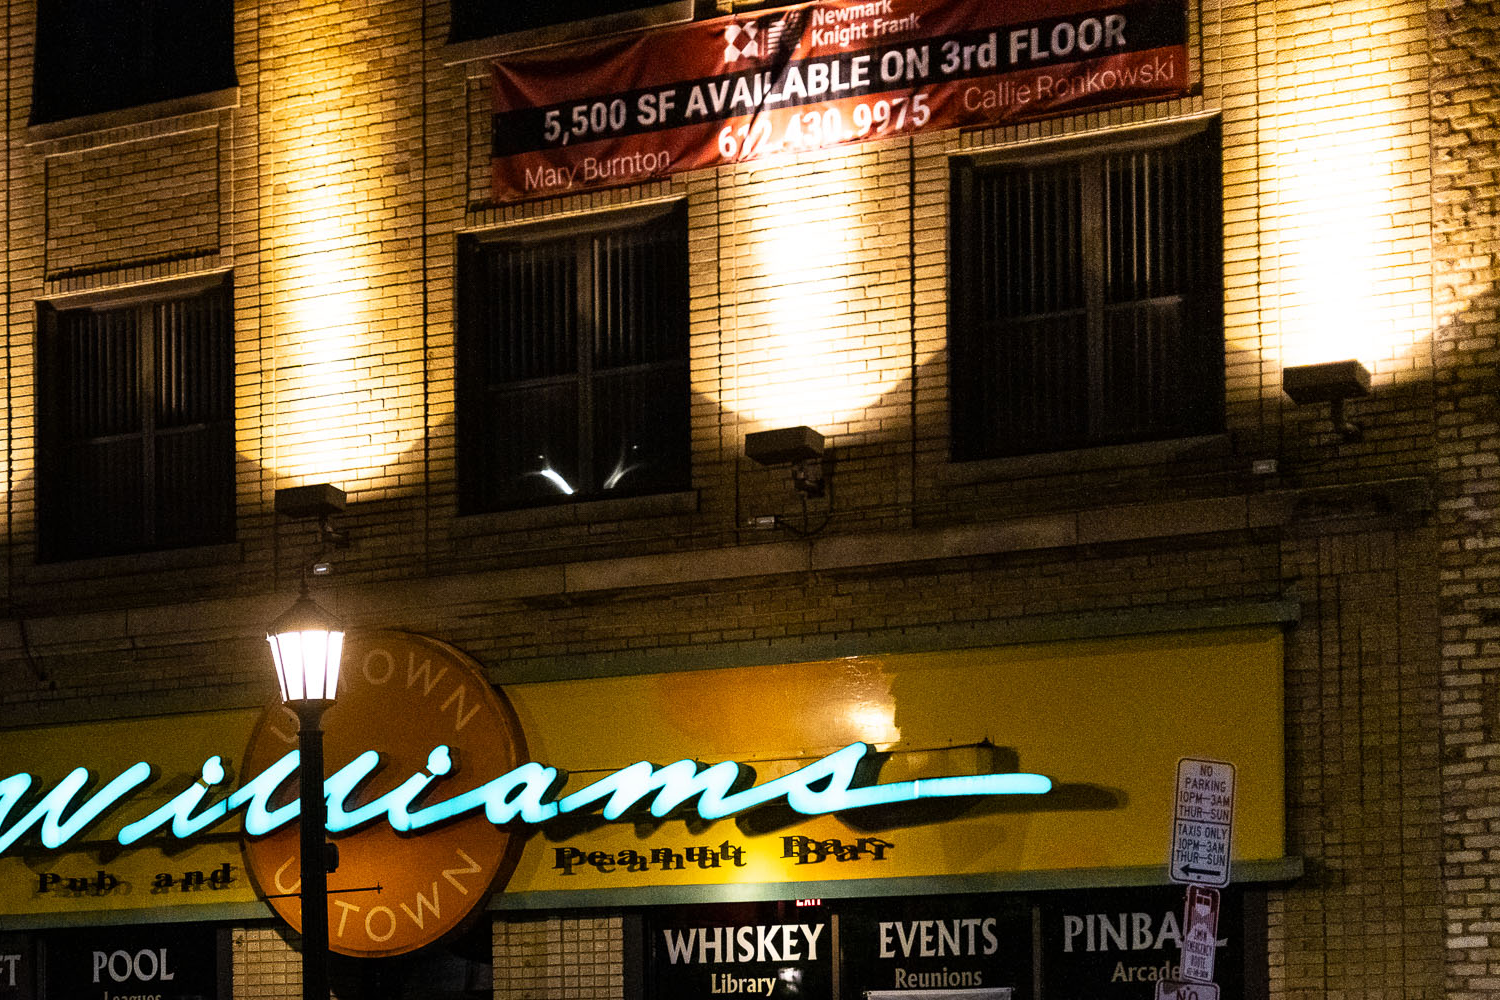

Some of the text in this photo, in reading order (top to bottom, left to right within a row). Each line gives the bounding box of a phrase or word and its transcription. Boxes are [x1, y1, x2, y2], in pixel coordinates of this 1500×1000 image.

[811, 13, 921, 47] Knight Frank
[812, 0, 893, 27] Newmark
[544, 14, 1127, 145] 5,500 SF AVAILABLE ON 3rd FLOOR
[965, 54, 1175, 112] Callie Ronkowski
[719, 93, 932, 158] 612.430.9975
[524, 150, 671, 191] Mary Burnton
[1185, 777, 1227, 793] PARKING
[1200, 765, 1213, 777] NO
[1178, 823, 1228, 840] TAXIS ONLY
[36, 834, 890, 894] Pub and Peanut Bar
[274, 848, 483, 942] UTOWN
[663, 923, 825, 965] WHISKEY
[879, 917, 998, 959] EVENTS
[1063, 911, 1229, 953] PINBA
[92, 949, 175, 983] POOL
[711, 972, 776, 997] Library
[894, 966, 982, 989] Reunions
[1111, 960, 1180, 983] Arcade
